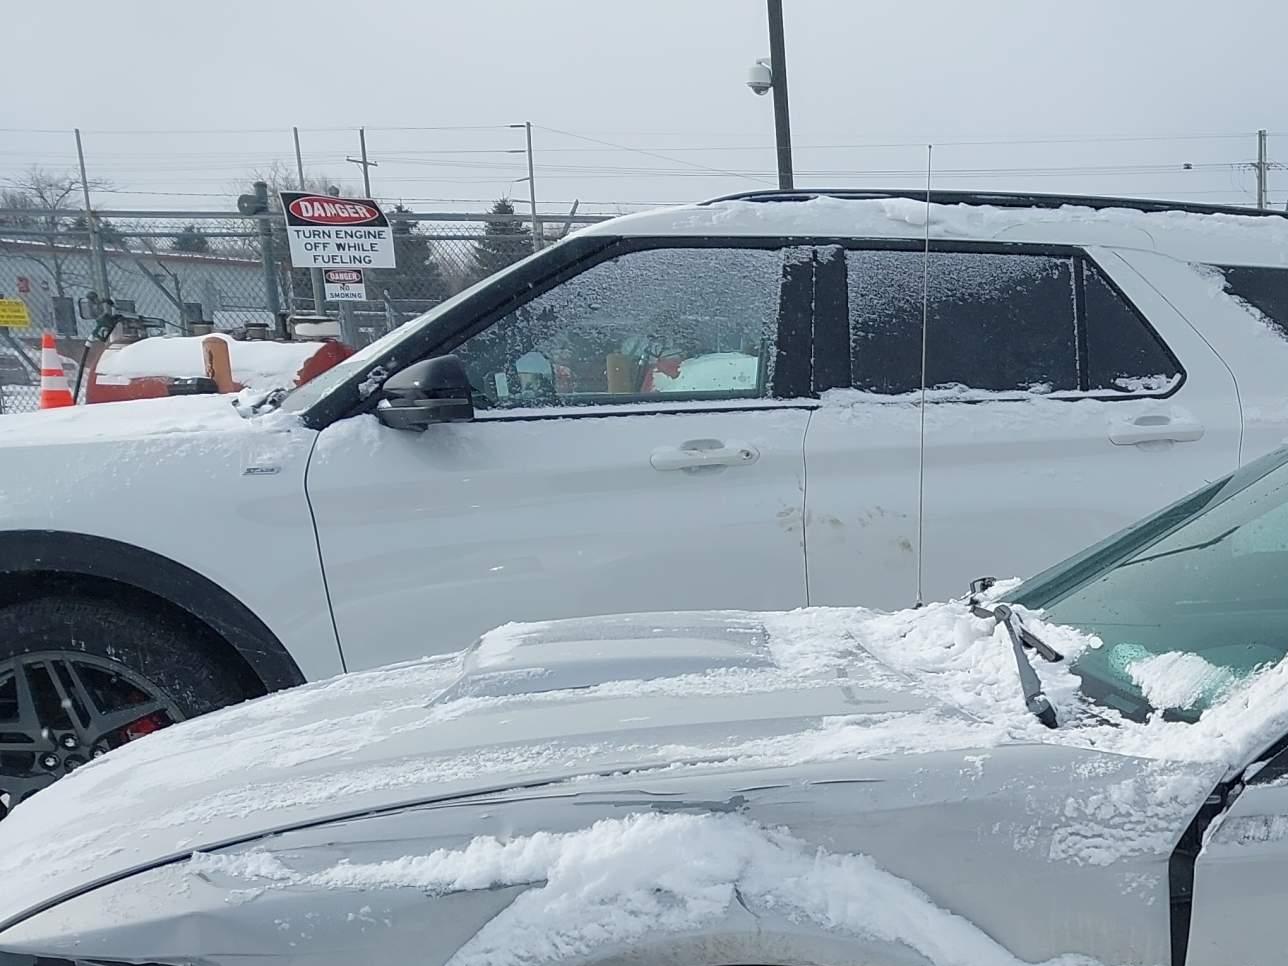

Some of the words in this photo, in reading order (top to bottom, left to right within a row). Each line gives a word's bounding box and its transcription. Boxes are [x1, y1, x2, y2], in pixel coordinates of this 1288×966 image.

[299, 201, 371, 218] DANGER
[294, 229, 331, 239] TURN
[335, 230, 387, 240] ENGINE
[304, 242, 331, 252] OFF
[336, 242, 379, 252] WHILE
[313, 254, 372, 265] FUELING
[329, 272, 358, 280] DANGER
